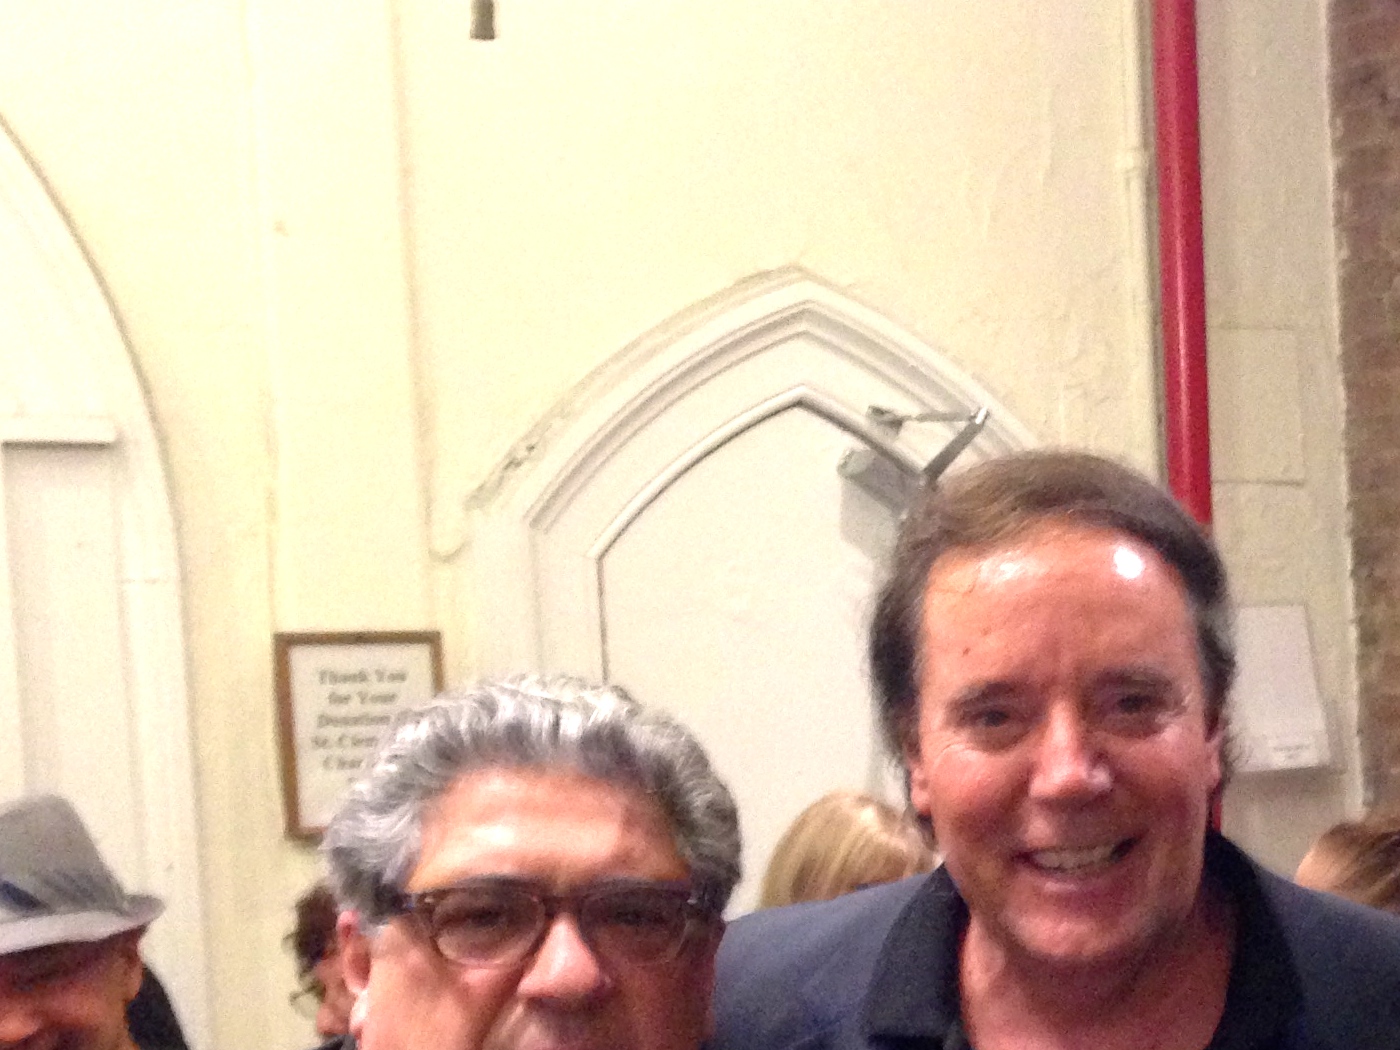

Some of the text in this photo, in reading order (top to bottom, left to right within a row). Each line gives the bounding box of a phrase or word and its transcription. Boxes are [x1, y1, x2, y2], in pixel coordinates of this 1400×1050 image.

[318, 668, 407, 685] Thank You
[328, 690, 397, 705] for Your
